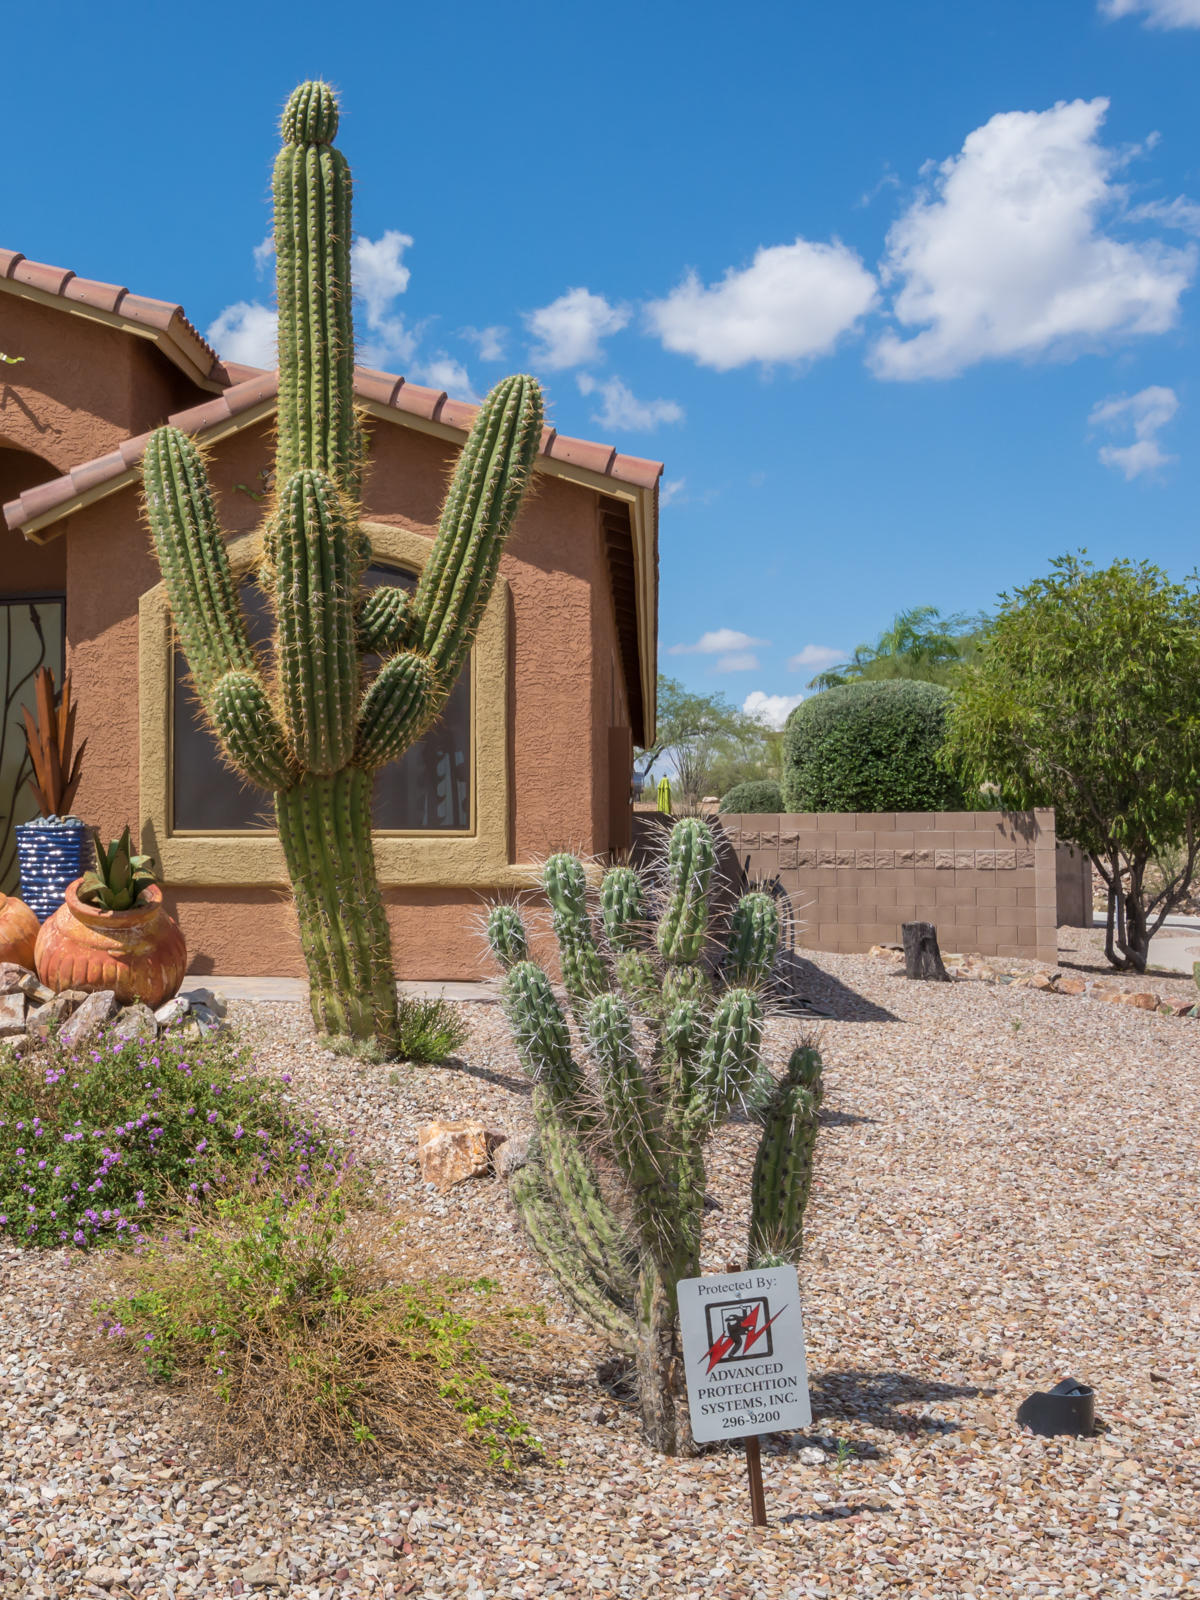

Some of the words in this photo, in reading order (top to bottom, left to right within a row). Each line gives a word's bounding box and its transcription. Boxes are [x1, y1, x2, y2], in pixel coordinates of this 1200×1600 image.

[698, 1279, 753, 1297] Protected
[757, 1277, 777, 1289] By:
[709, 1363, 784, 1383] ADVANCED
[698, 1376, 798, 1400] PROTECHTION
[701, 1397, 767, 1416] SYSTEMS,
[770, 1392, 798, 1406] INC.
[722, 1411, 781, 1429] 296-9200
